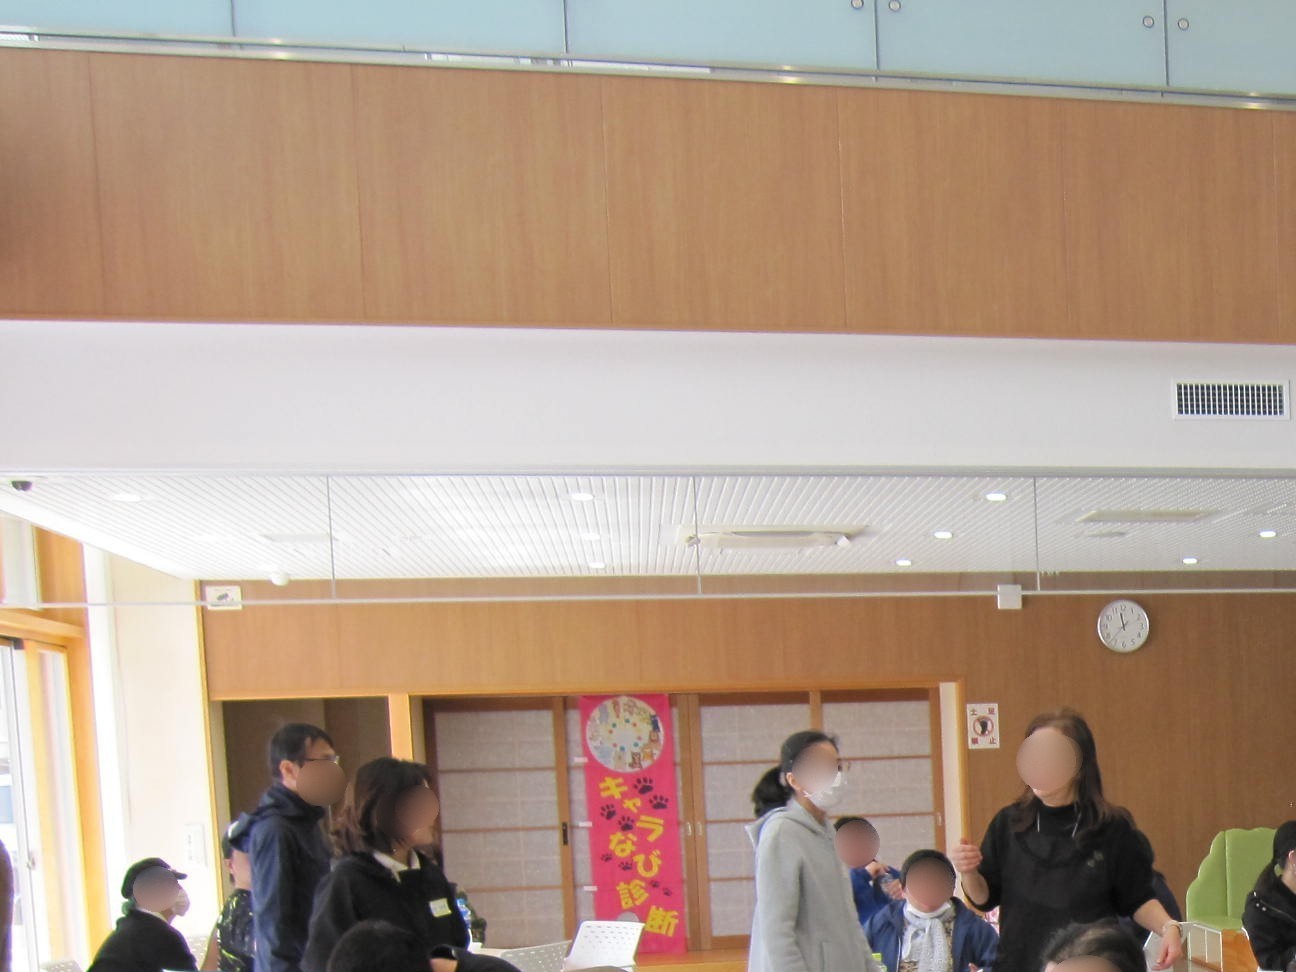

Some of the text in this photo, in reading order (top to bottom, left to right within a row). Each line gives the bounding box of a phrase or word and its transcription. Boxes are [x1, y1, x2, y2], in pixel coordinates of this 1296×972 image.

[598, 775, 679, 938] キャラなび診断
